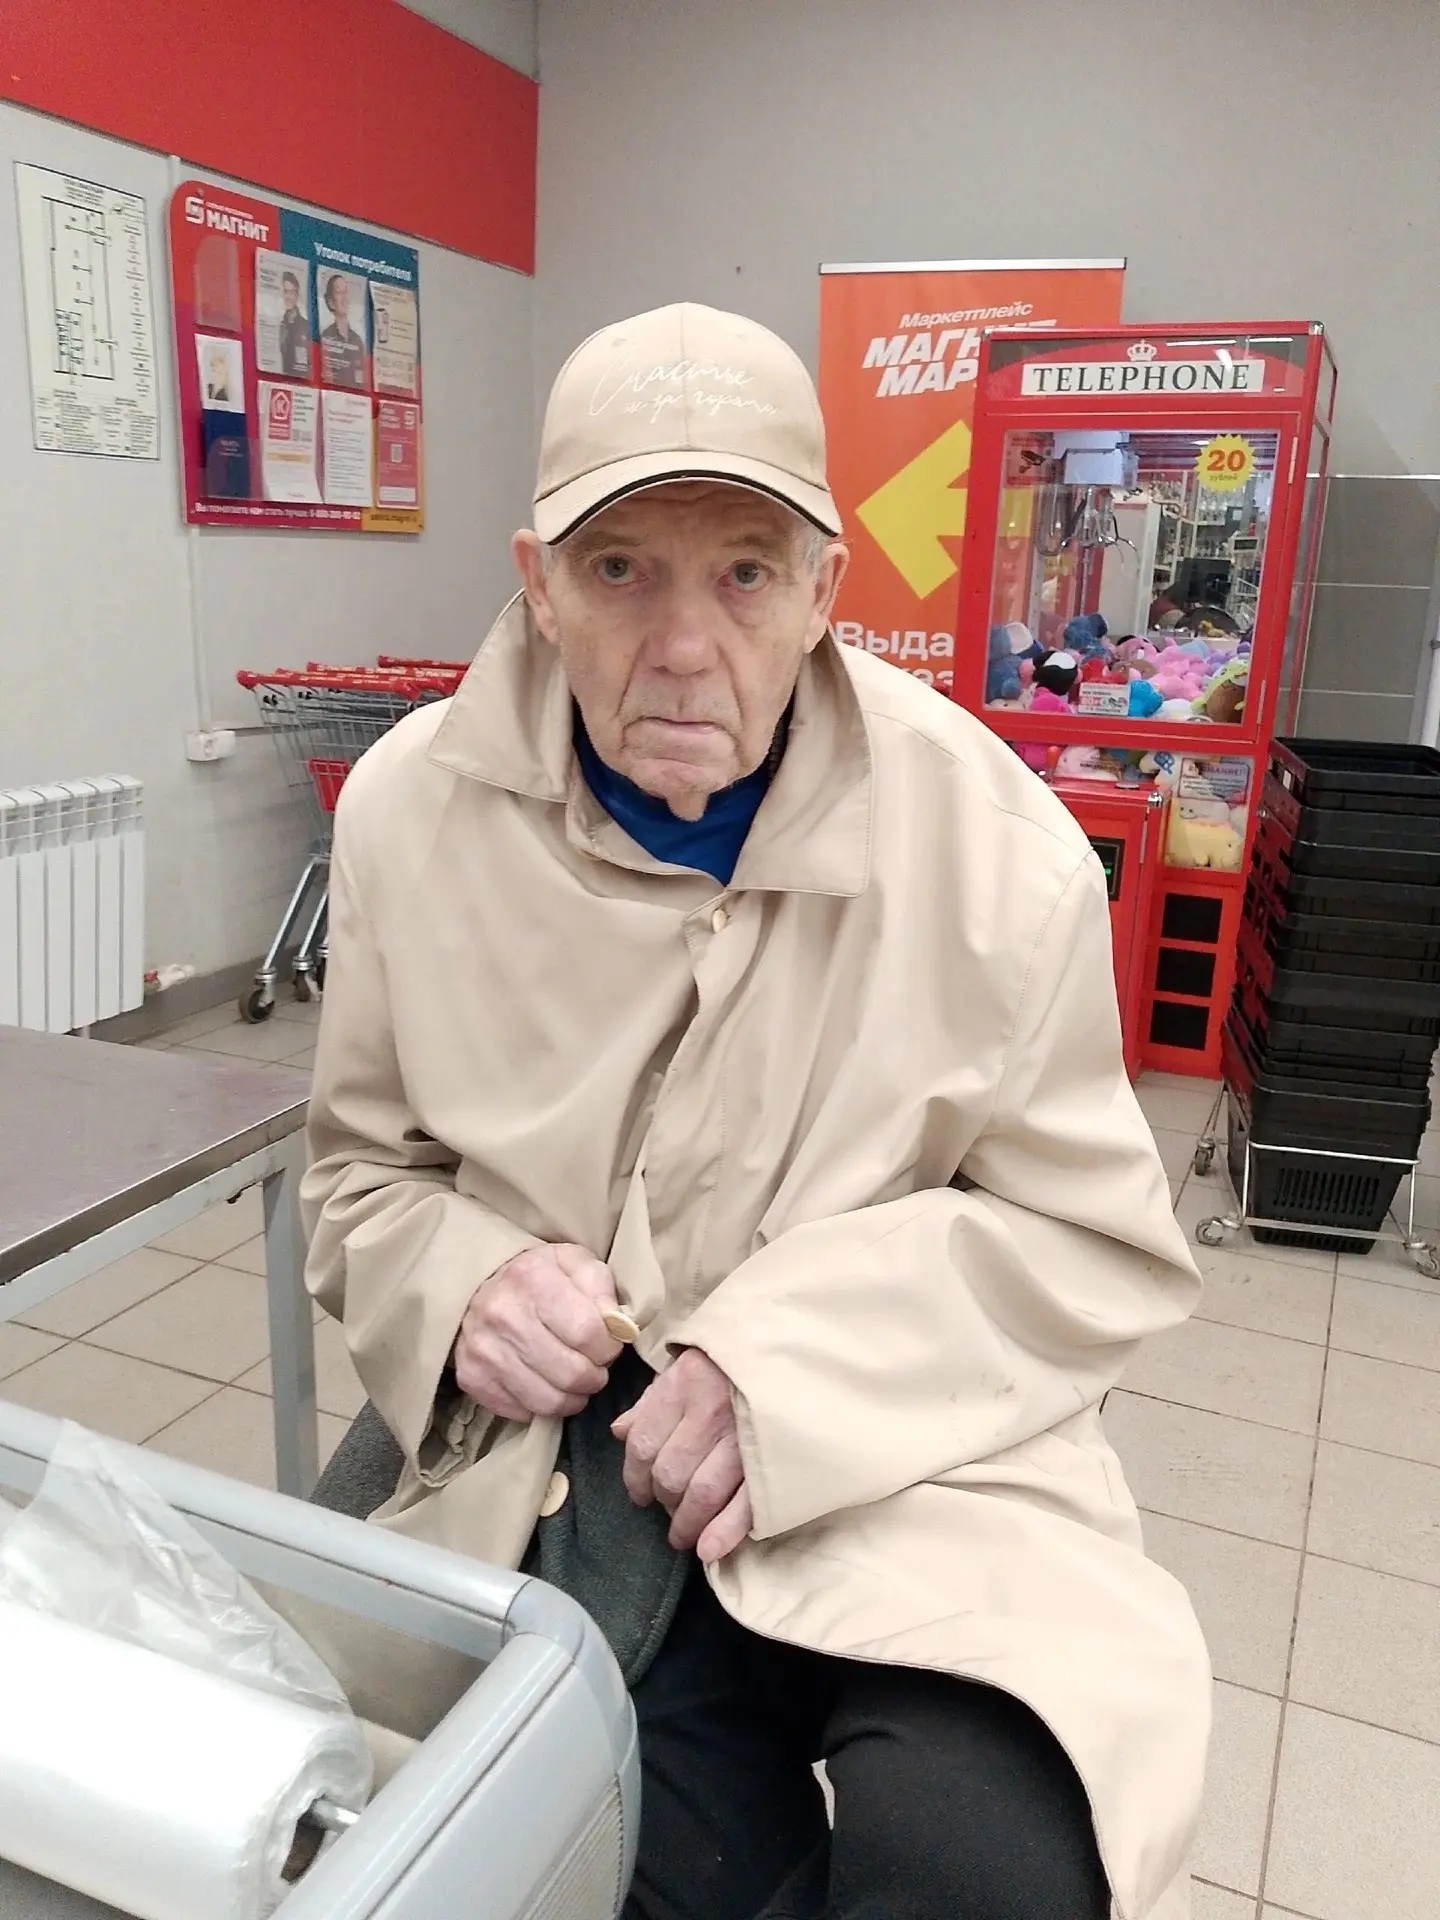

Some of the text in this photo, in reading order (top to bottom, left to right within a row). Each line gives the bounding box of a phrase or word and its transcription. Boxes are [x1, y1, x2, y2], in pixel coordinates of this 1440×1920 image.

[206, 209, 269, 242] МАГНИТ
[899, 301, 1033, 329] Маркетплейс
[875, 358, 979, 397] МАР
[1032, 364, 1250, 393] TELEPHONE
[1207, 449, 1246, 472] 20
[835, 621, 954, 661] Выда
